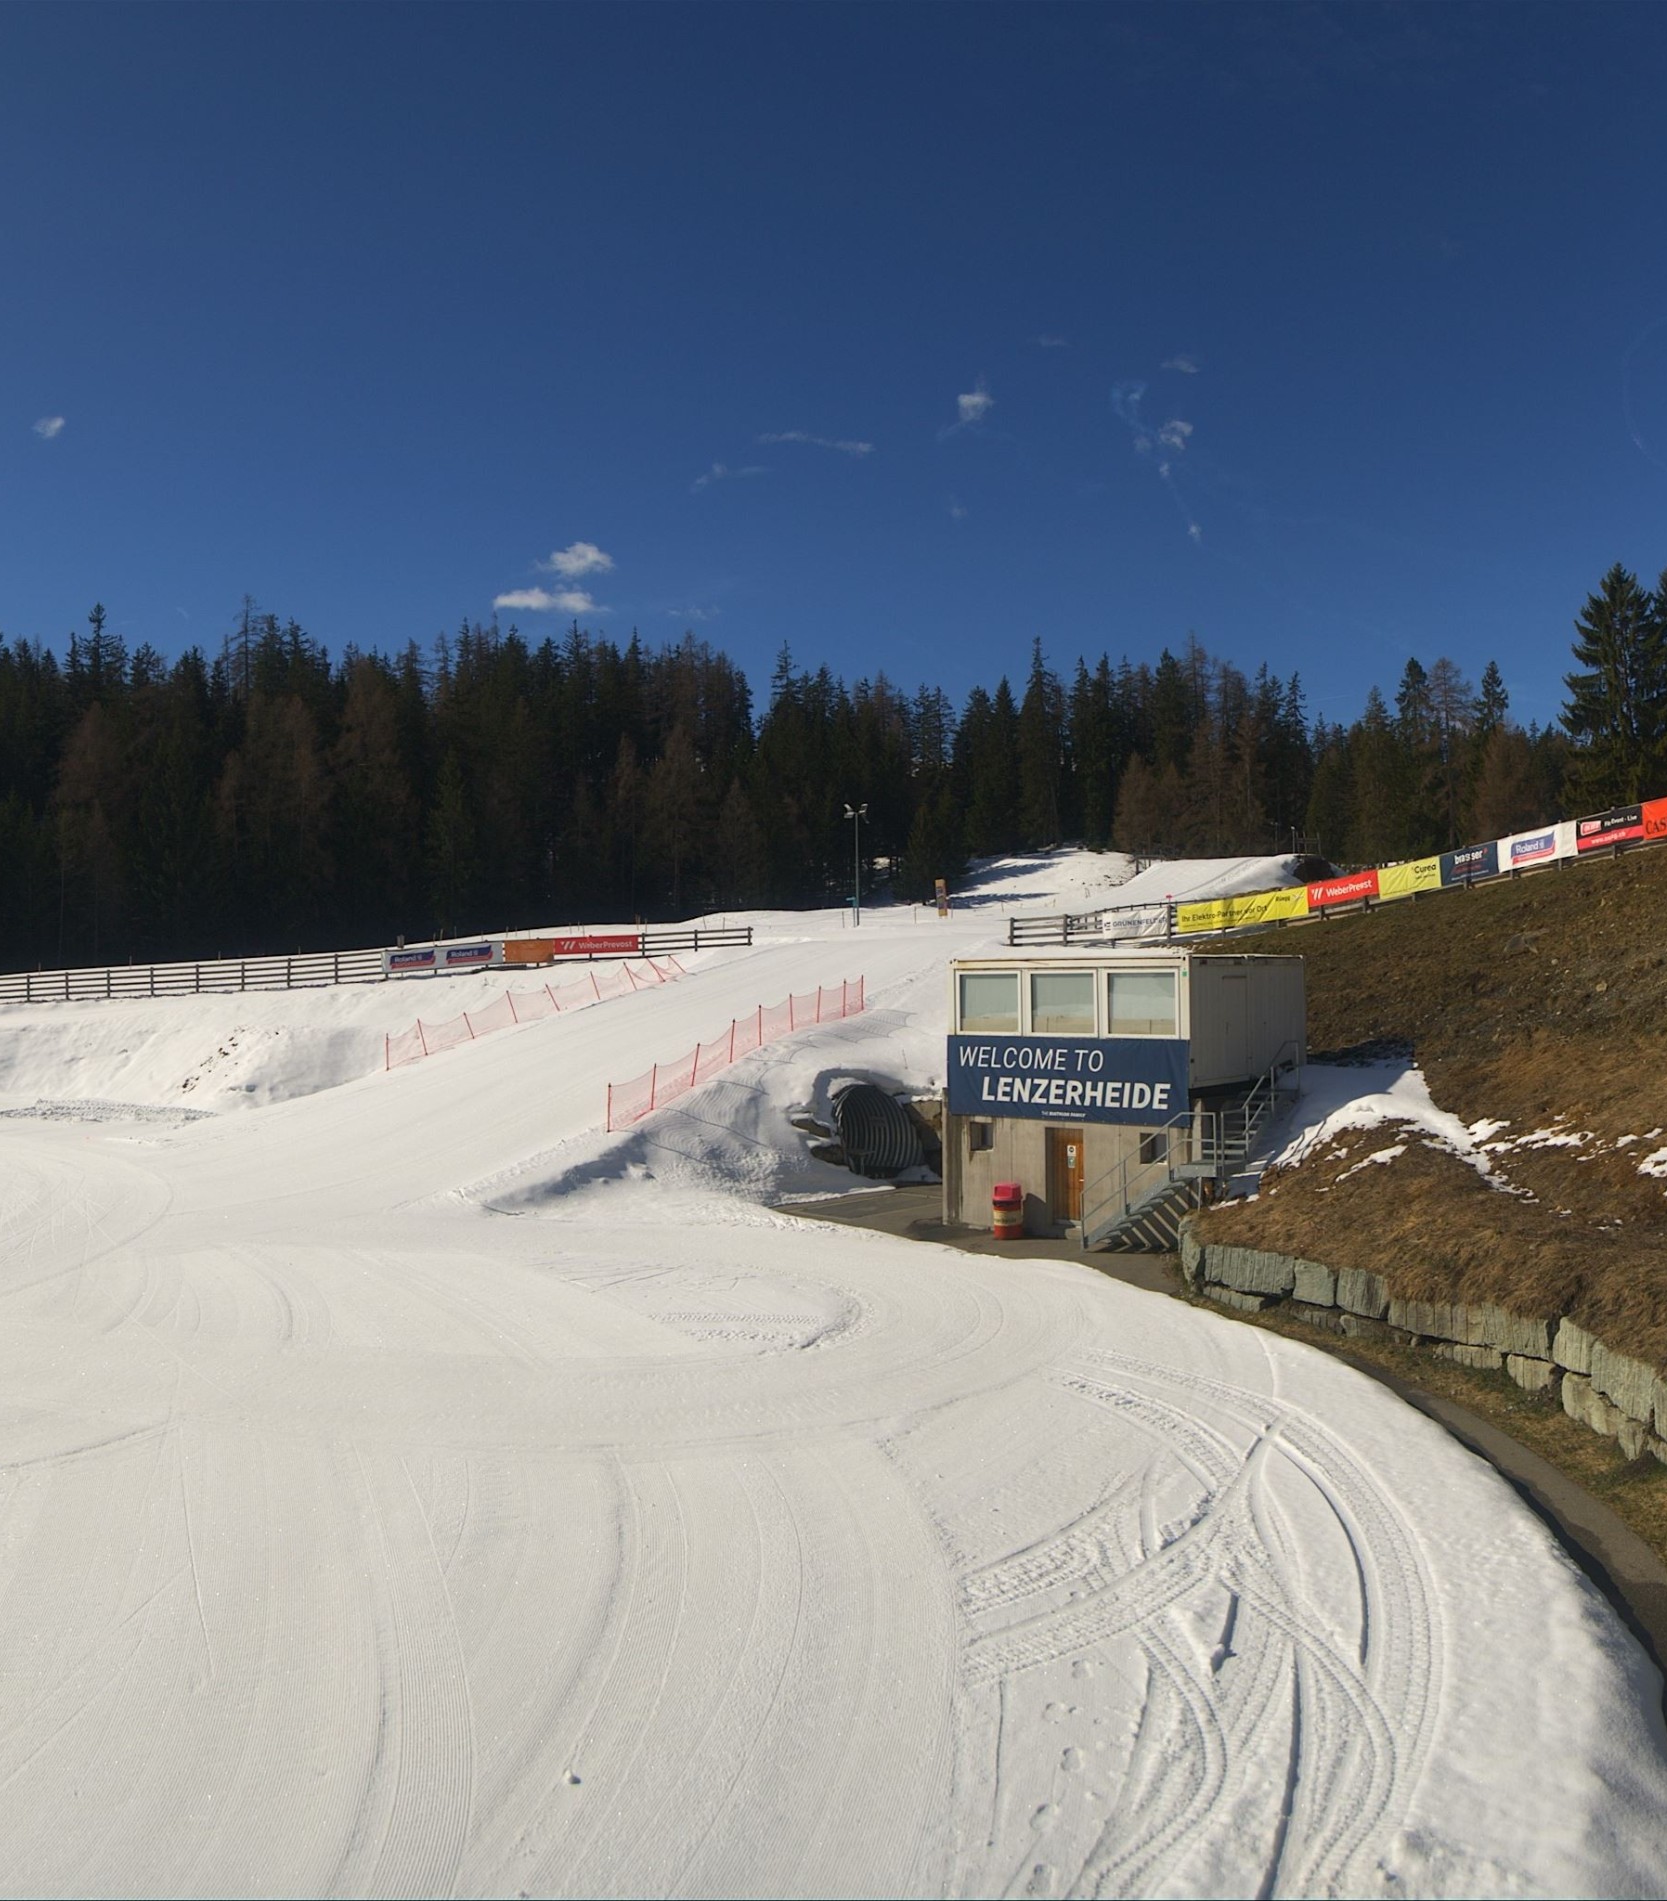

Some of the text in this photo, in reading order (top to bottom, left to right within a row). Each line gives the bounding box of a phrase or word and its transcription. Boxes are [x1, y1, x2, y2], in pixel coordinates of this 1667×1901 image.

[1515, 841, 1538, 854] Roland
[578, 940, 633, 949] WeberPrevost
[959, 1045, 1104, 1072] WELCOME TO
[982, 1076, 1171, 1110] LENZERHEIDE
